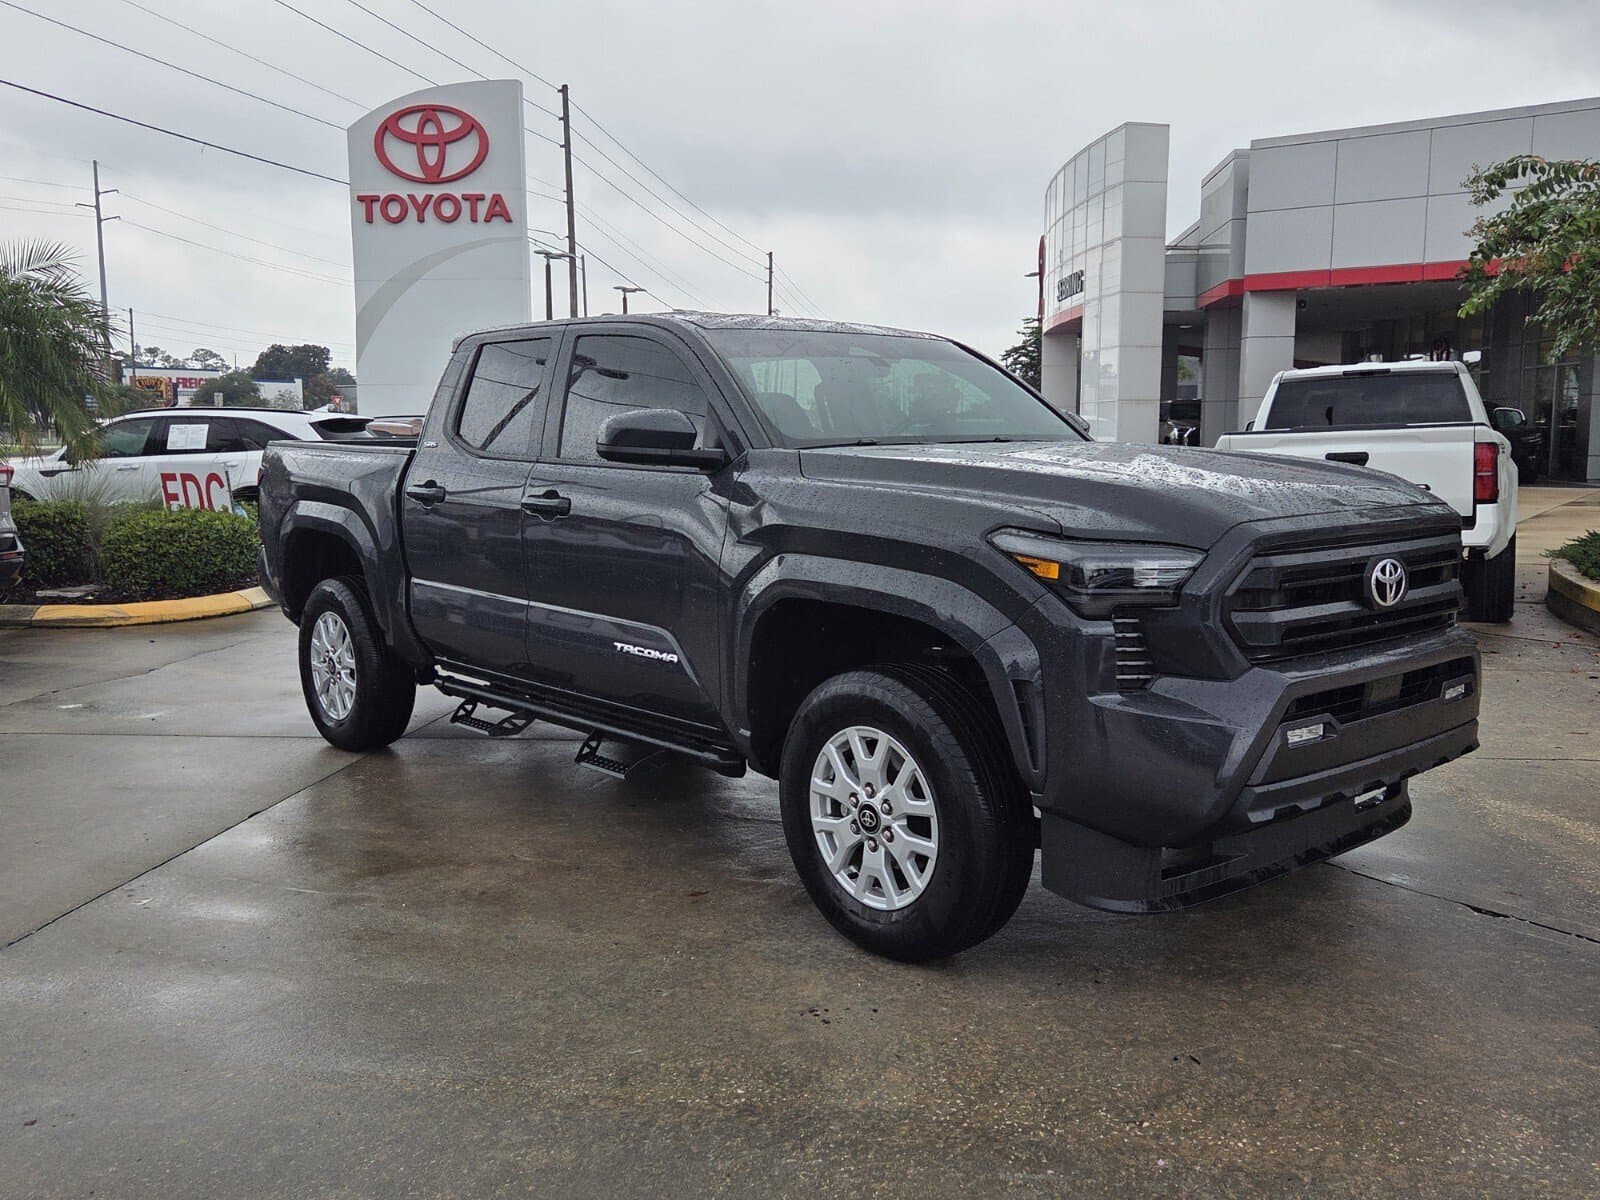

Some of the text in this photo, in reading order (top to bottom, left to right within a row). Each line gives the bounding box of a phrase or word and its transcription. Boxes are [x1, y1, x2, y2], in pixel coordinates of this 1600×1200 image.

[357, 193, 513, 224] TOYOTA
[176, 377, 208, 390] FREIG
[613, 641, 679, 664] TACOMA
